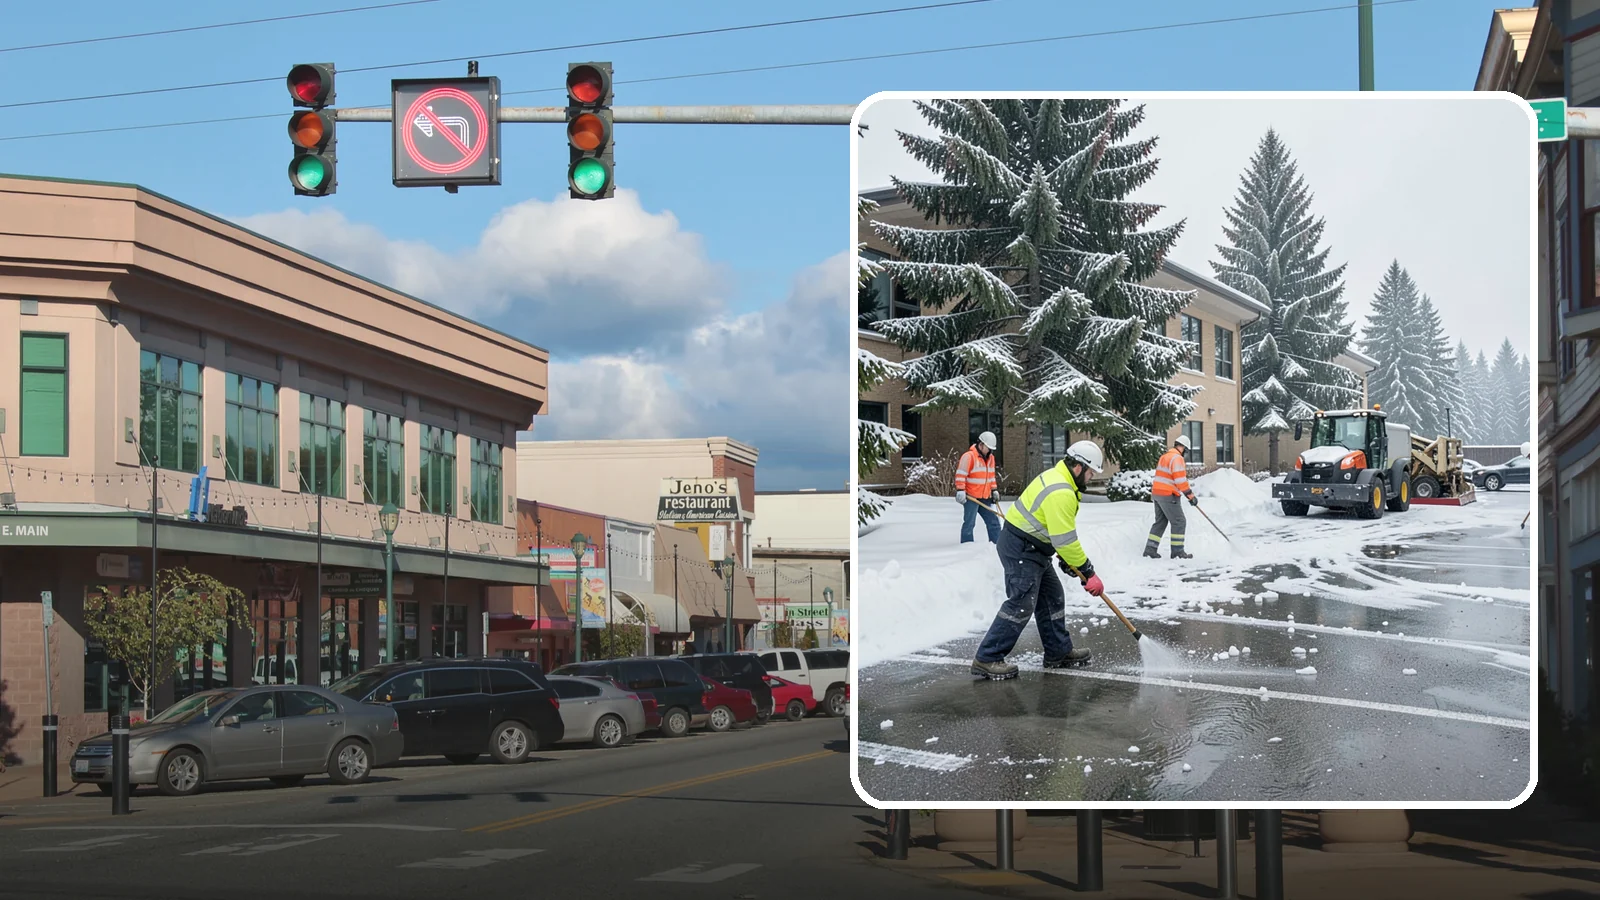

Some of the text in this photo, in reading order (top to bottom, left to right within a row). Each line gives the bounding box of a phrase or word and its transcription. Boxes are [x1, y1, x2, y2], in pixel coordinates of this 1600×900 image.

[670, 480, 727, 494] Jeno's
[665, 496, 731, 509] restaurant
[658, 510, 682, 519] Italian
[686, 509, 715, 519] American
[714, 509, 738, 519] Cuisine
[2, 525, 49, 536] E. MAIN
[785, 607, 829, 617] in Street
[788, 619, 824, 627] lass
